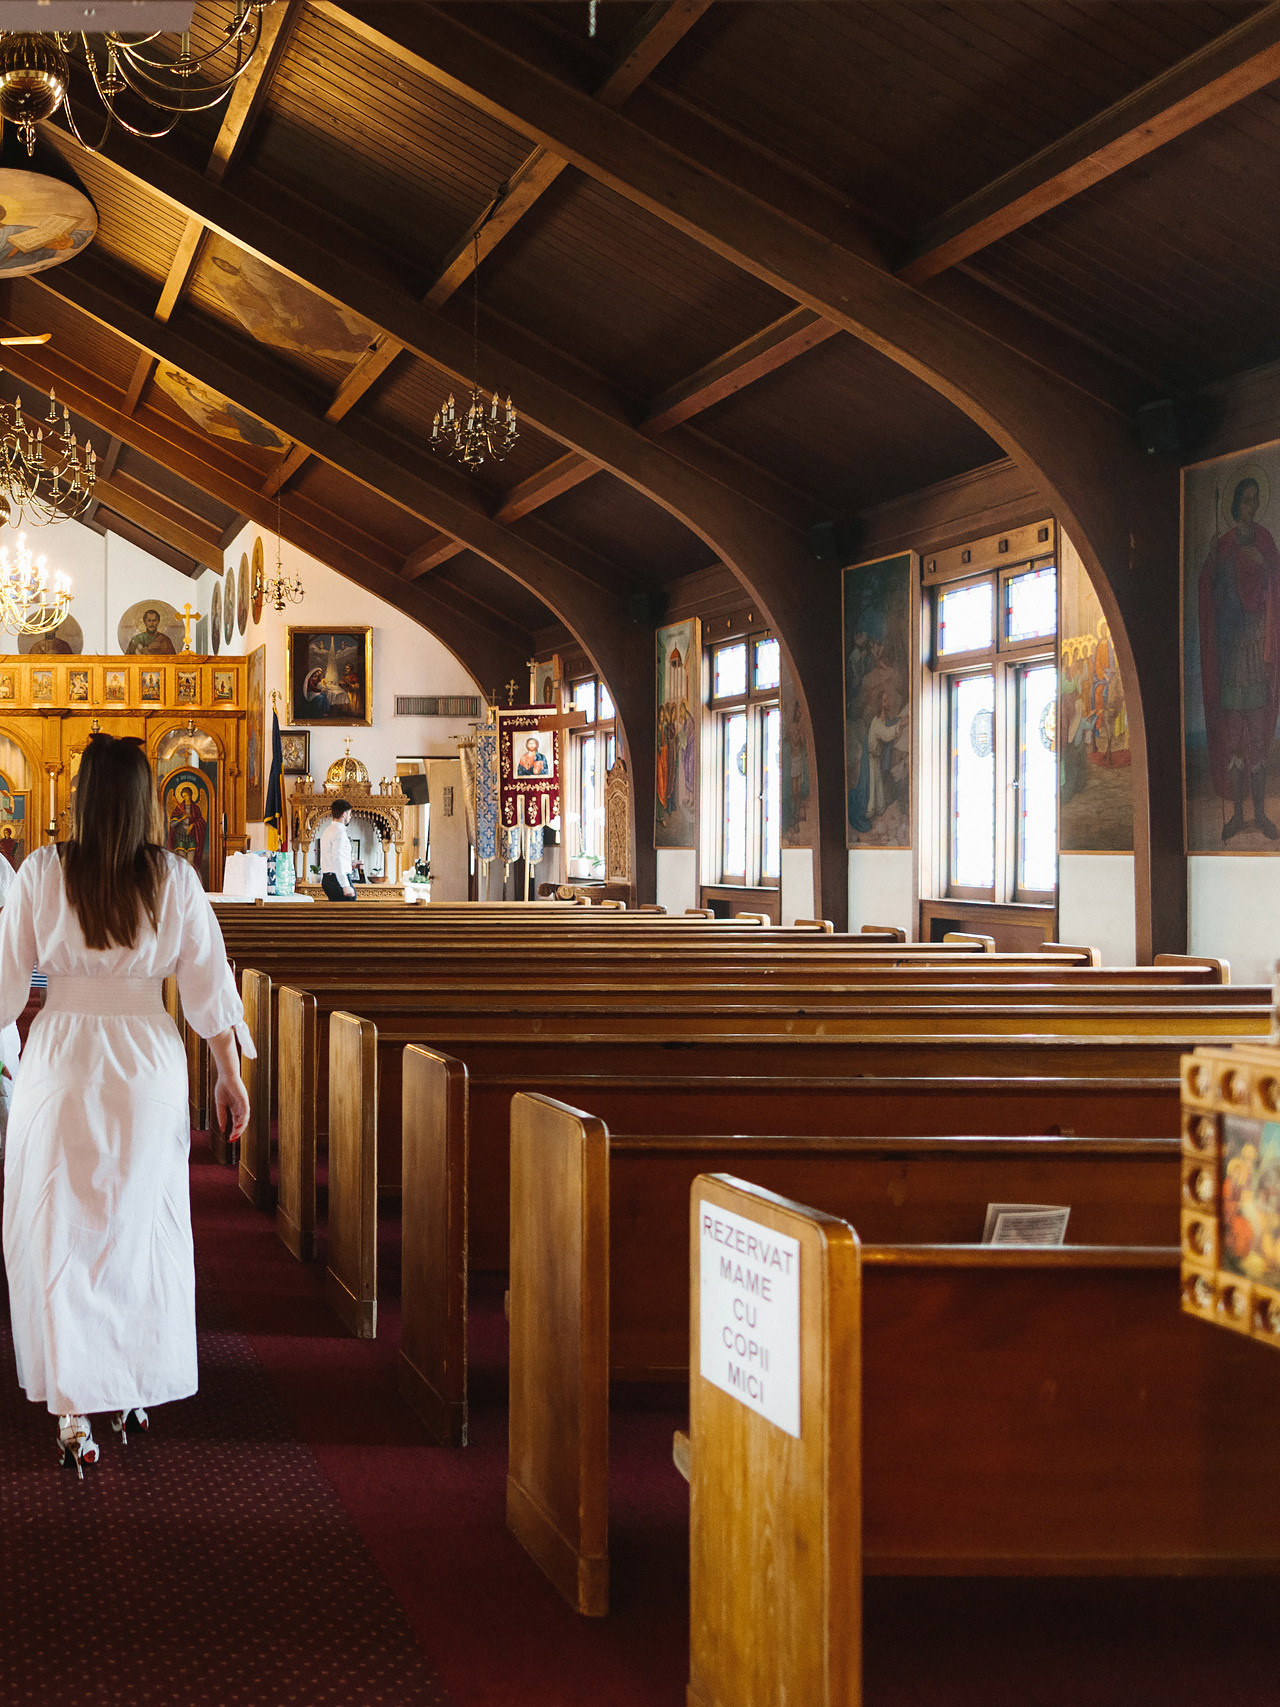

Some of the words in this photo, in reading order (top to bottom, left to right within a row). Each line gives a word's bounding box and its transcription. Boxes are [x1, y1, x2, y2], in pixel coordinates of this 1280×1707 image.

[703, 1215, 793, 1275] REZERVAT
[720, 1256, 772, 1302] MAME
[733, 1298, 757, 1328] CU
[722, 1326, 769, 1373] COPII
[728, 1361, 764, 1403] MICI
